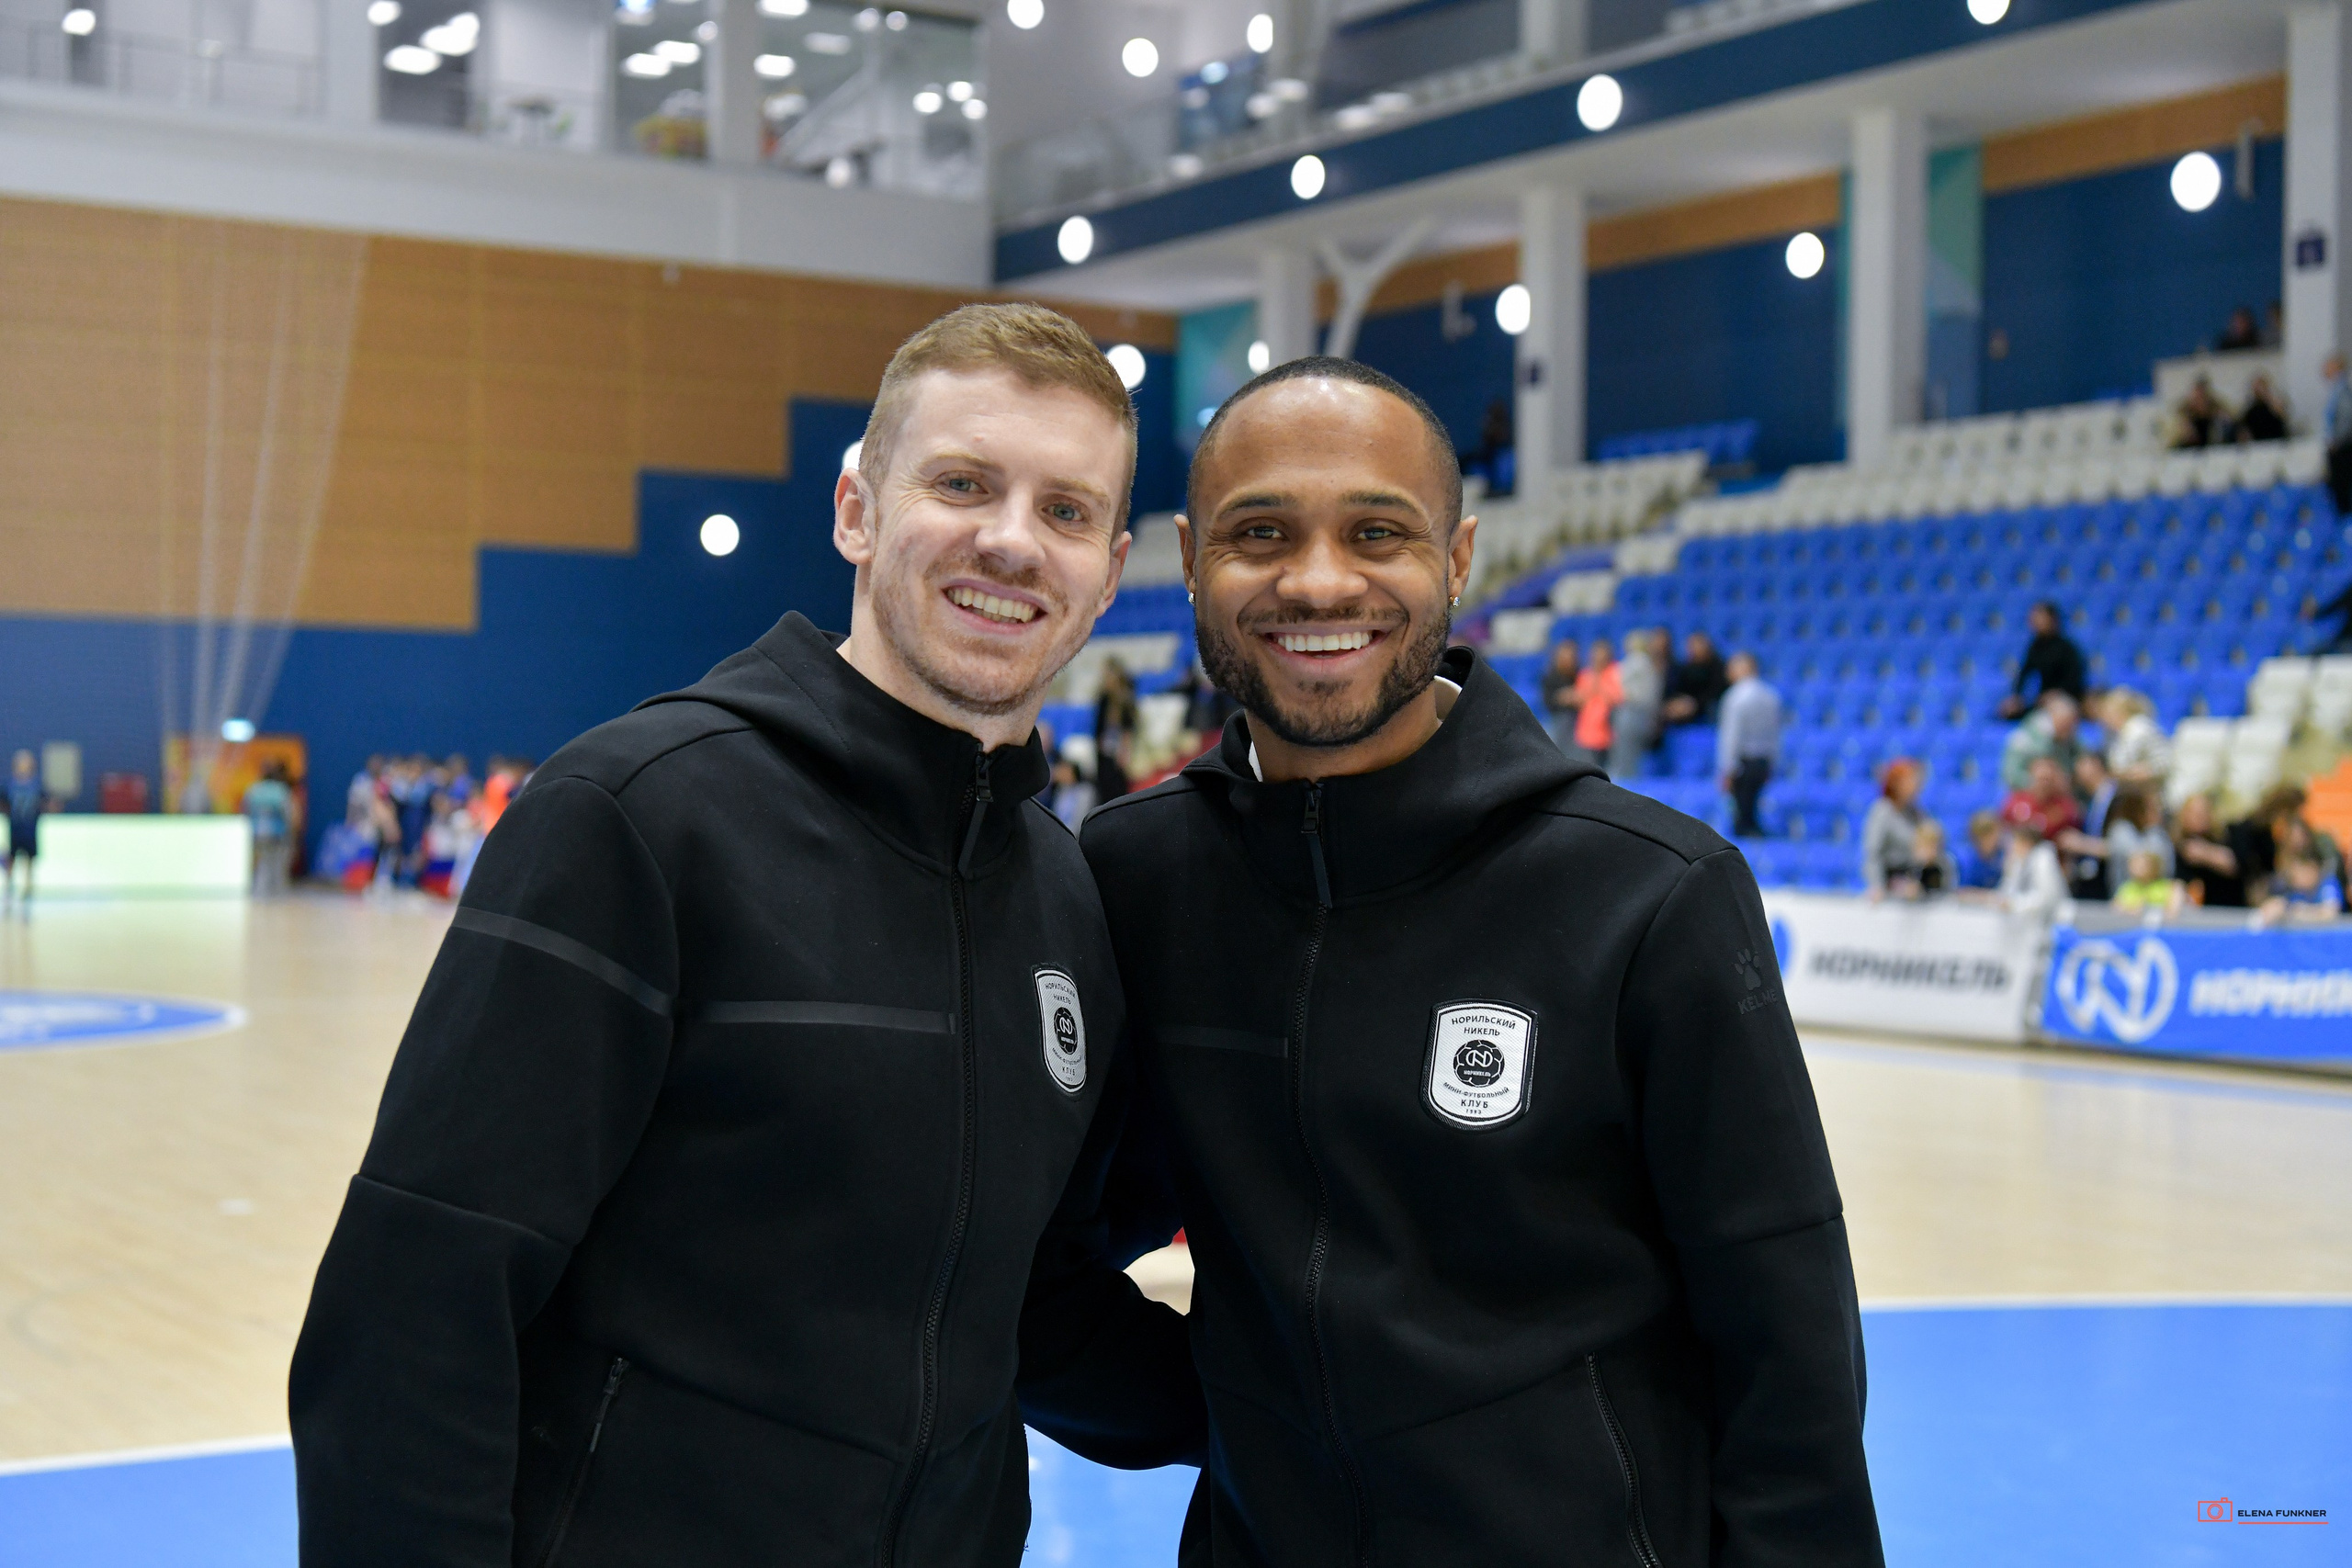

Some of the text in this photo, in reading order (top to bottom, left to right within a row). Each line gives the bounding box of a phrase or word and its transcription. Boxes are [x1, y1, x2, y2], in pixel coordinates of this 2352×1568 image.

[1737, 989, 1779, 1014] KELME
[1452, 1015, 1516, 1030] НОРИЛЬСКИЙ
[1464, 1027, 1500, 1036] НИКЕЛЬ
[1442, 1081, 1510, 1099] МИНИ-ФУТБОЛЬНЫЙ
[1460, 1099, 1488, 1109] КЛУБ
